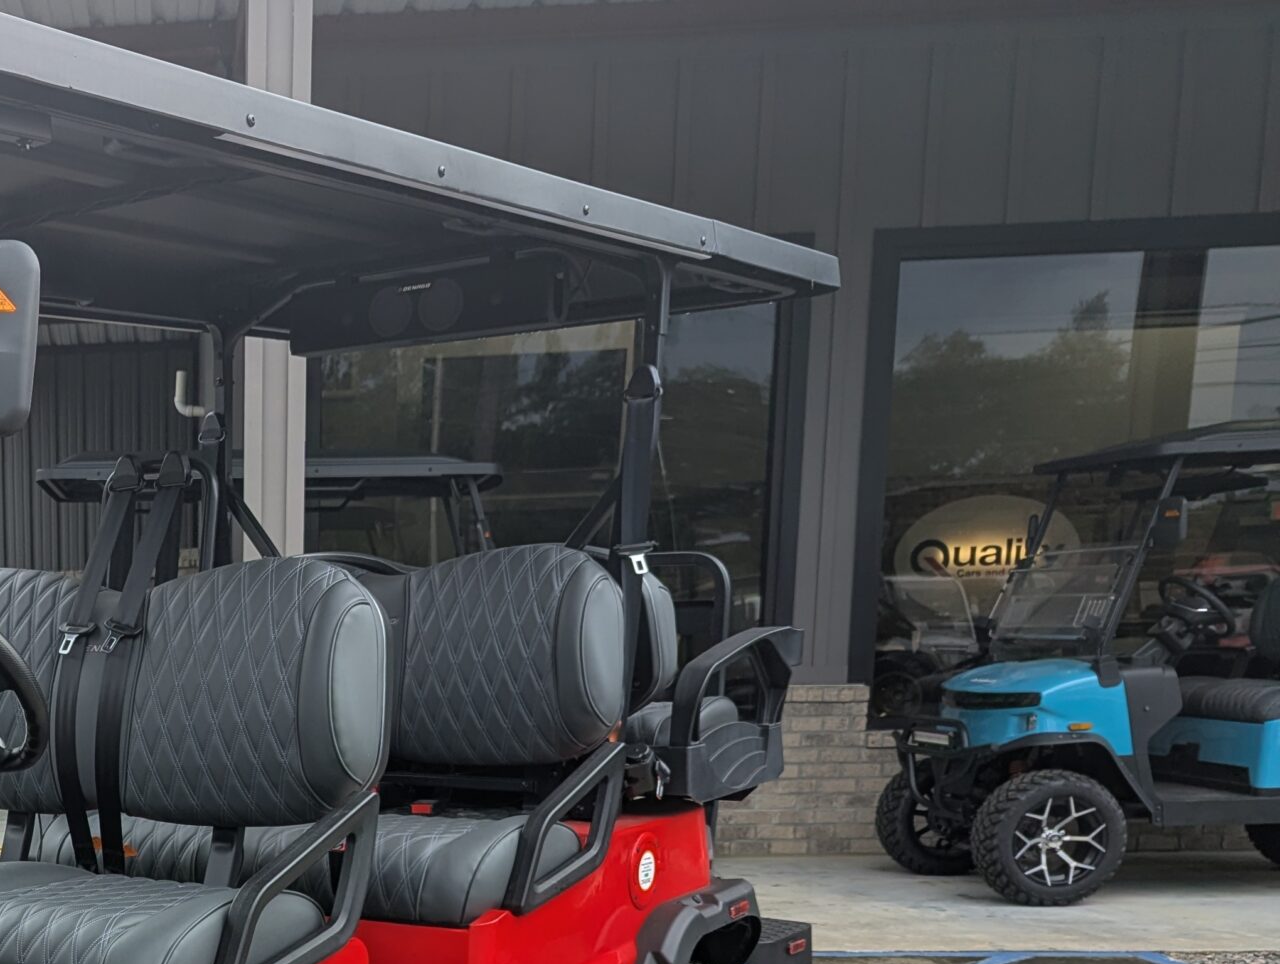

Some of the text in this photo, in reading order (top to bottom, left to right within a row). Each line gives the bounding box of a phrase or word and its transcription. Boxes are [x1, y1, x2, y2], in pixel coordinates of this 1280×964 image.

[910, 537, 1066, 576] Qualiy
[956, 568, 982, 578] Cars
[984, 567, 1006, 577] and
